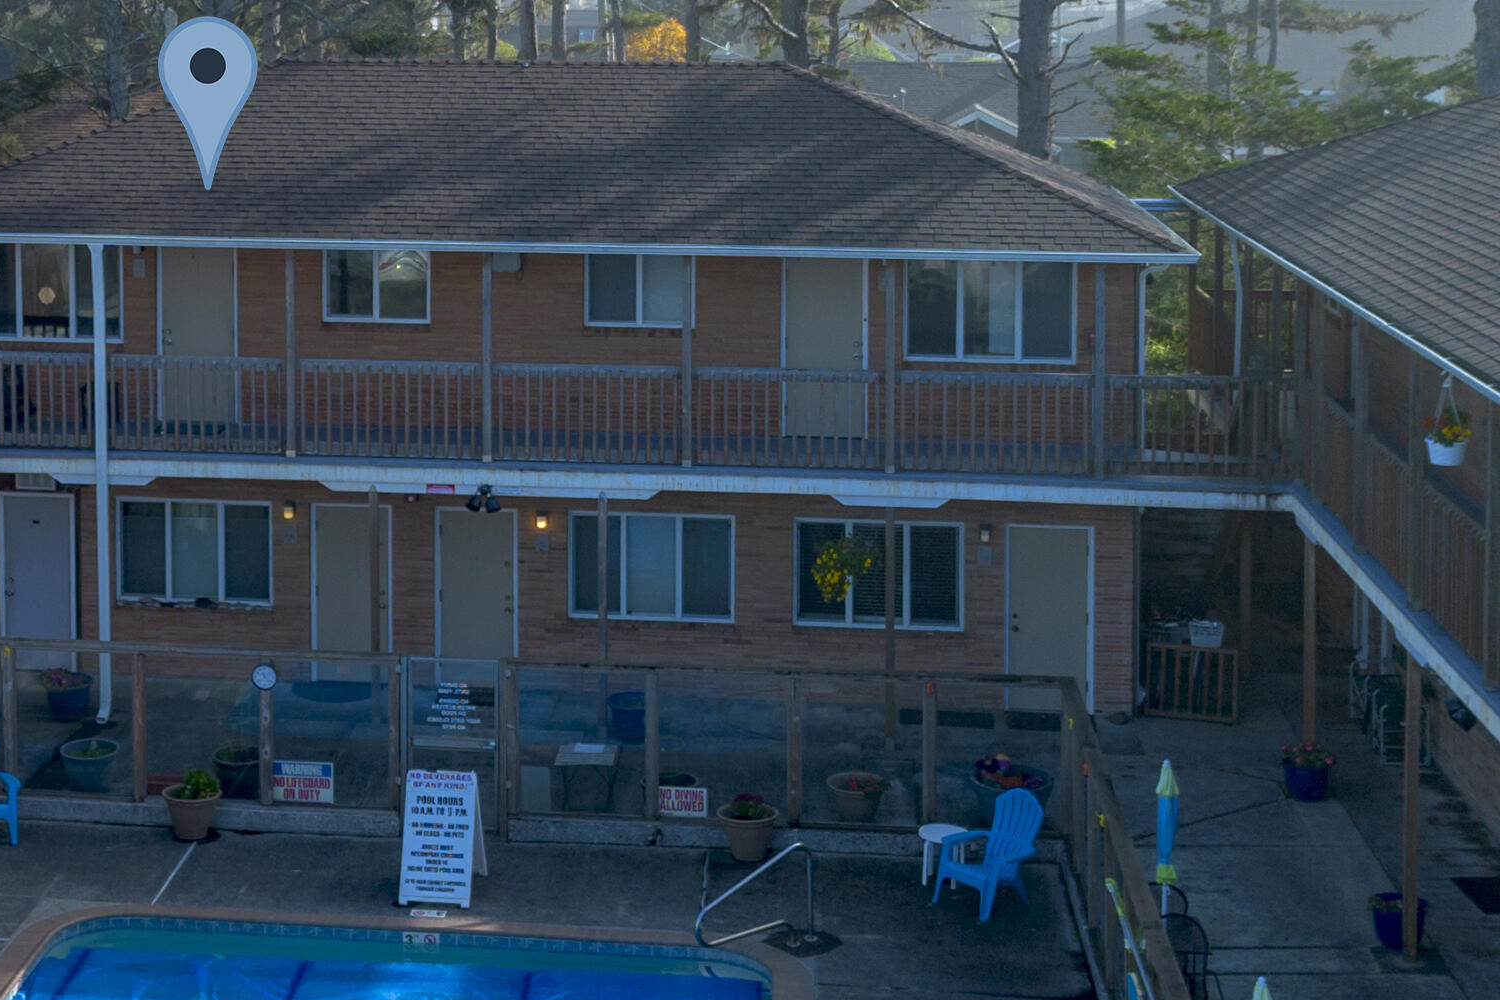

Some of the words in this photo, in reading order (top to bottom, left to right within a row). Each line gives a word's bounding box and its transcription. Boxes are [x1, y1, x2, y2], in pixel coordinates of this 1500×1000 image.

[273, 776, 284, 787] NO
[287, 777, 330, 789] LIFEGUARD
[284, 788, 295, 800] ON
[298, 789, 320, 800] DUTY
[660, 789, 672, 800] NO
[675, 789, 704, 801] DIVING
[416, 795, 436, 805] POOL
[437, 796, 464, 806] HOURS
[660, 800, 704, 812] ALLOWED
[436, 807, 445, 816] TO
[404, 934, 413, 945] 3
